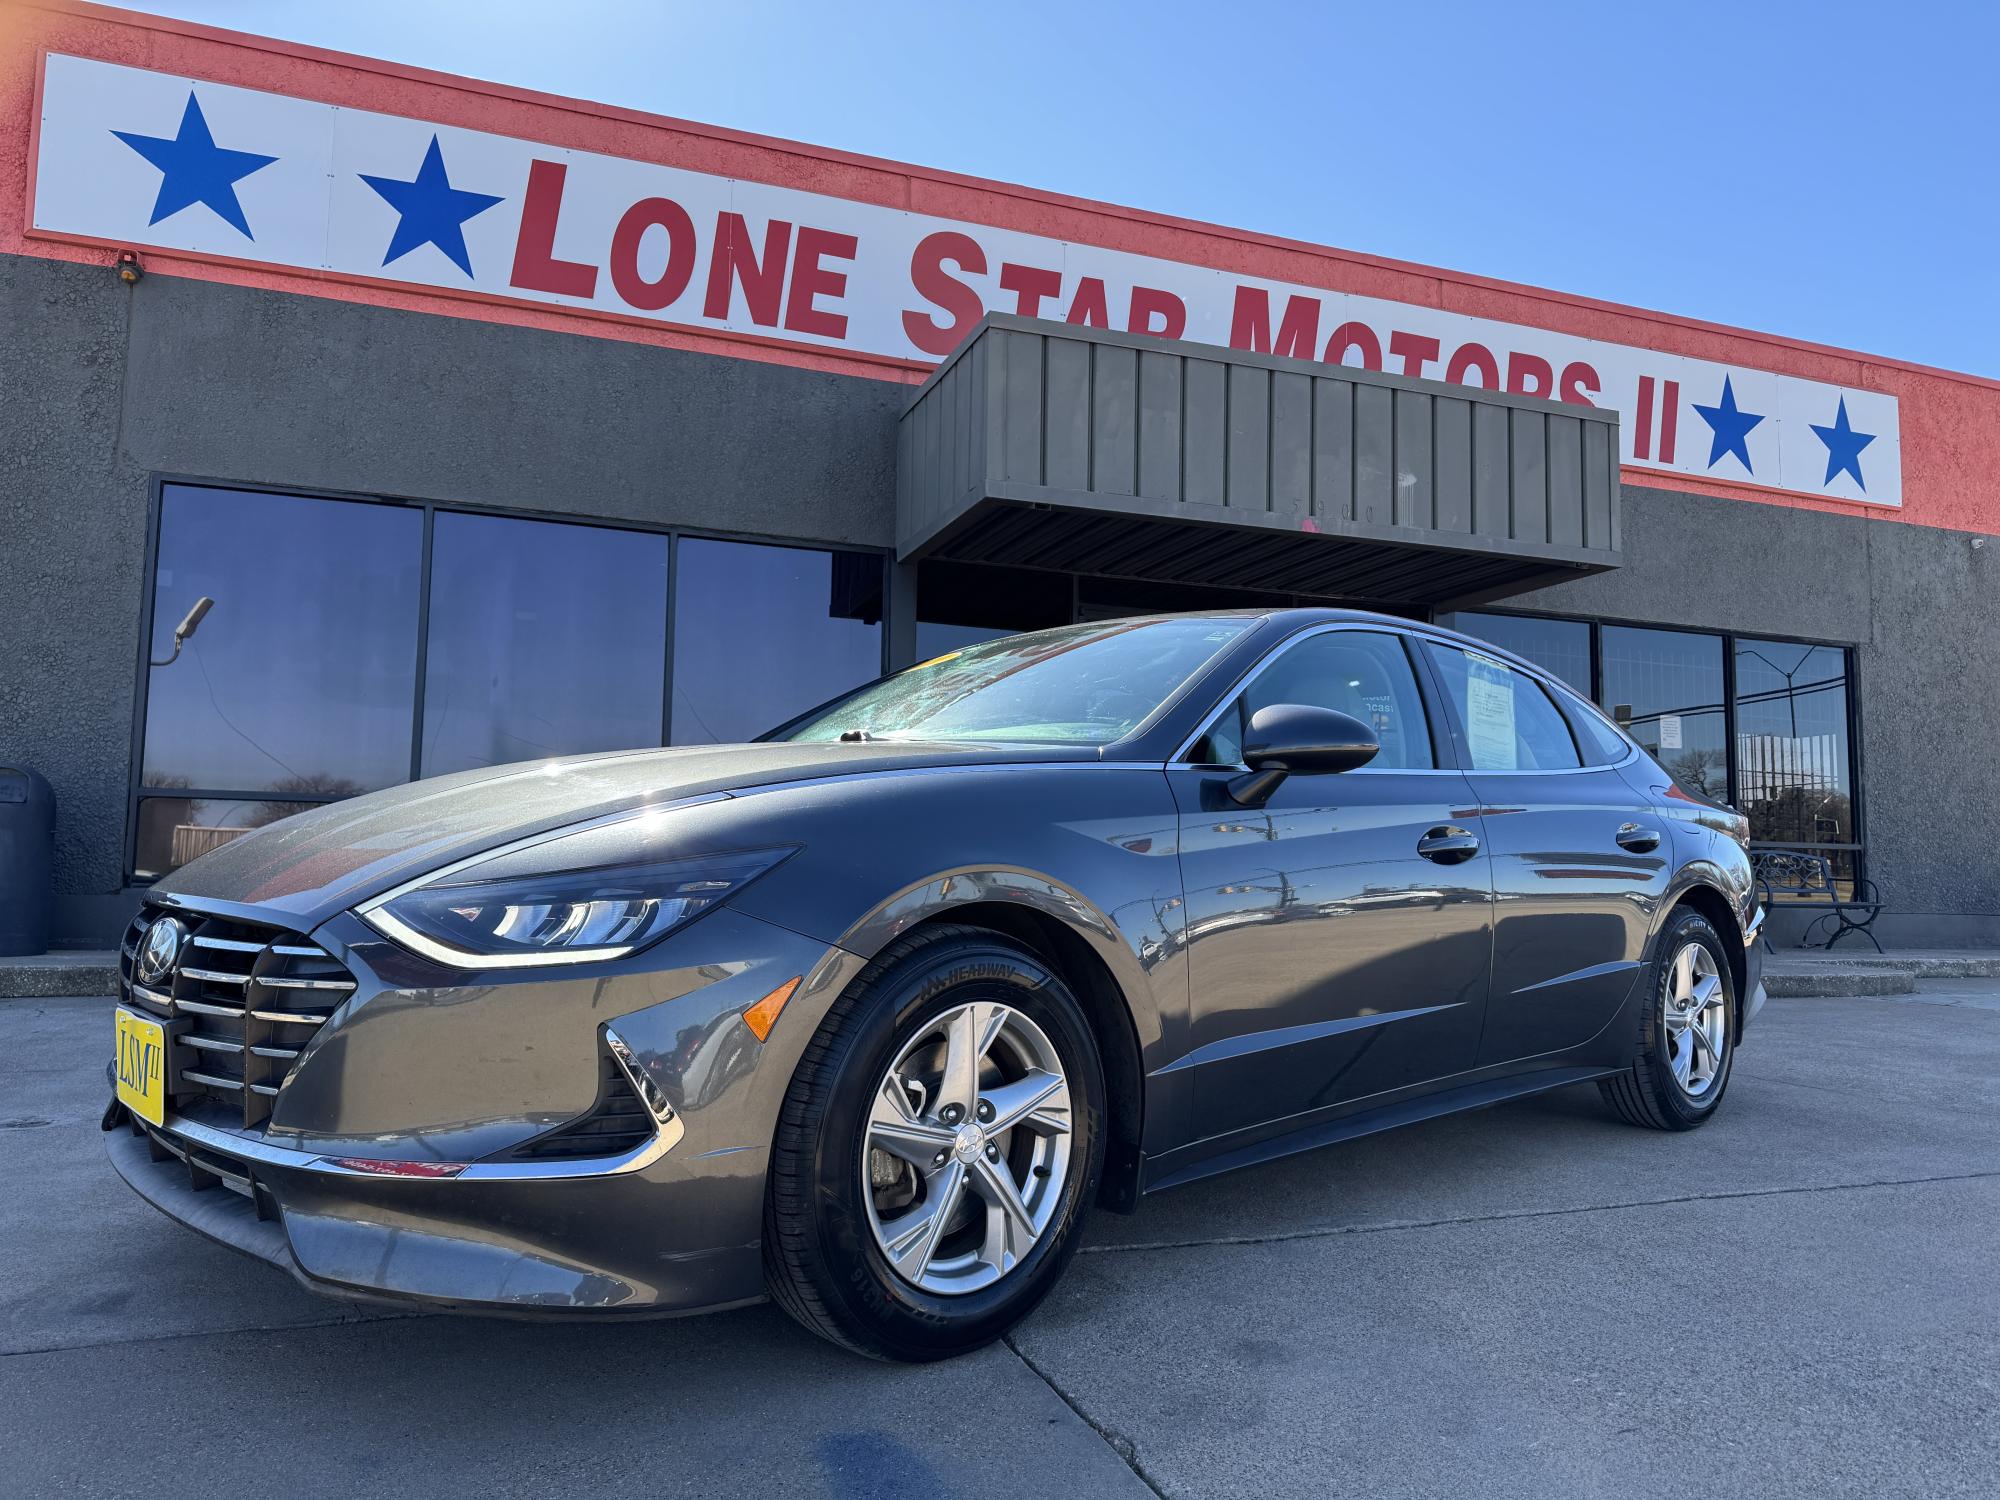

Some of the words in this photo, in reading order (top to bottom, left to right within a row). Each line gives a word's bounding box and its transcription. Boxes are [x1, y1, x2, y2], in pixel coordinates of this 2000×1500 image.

[509, 158, 858, 340] LONE
[901, 231, 1187, 356] STAR
[1633, 375, 1680, 465] II
[948, 963, 1016, 984] HEADWAY
